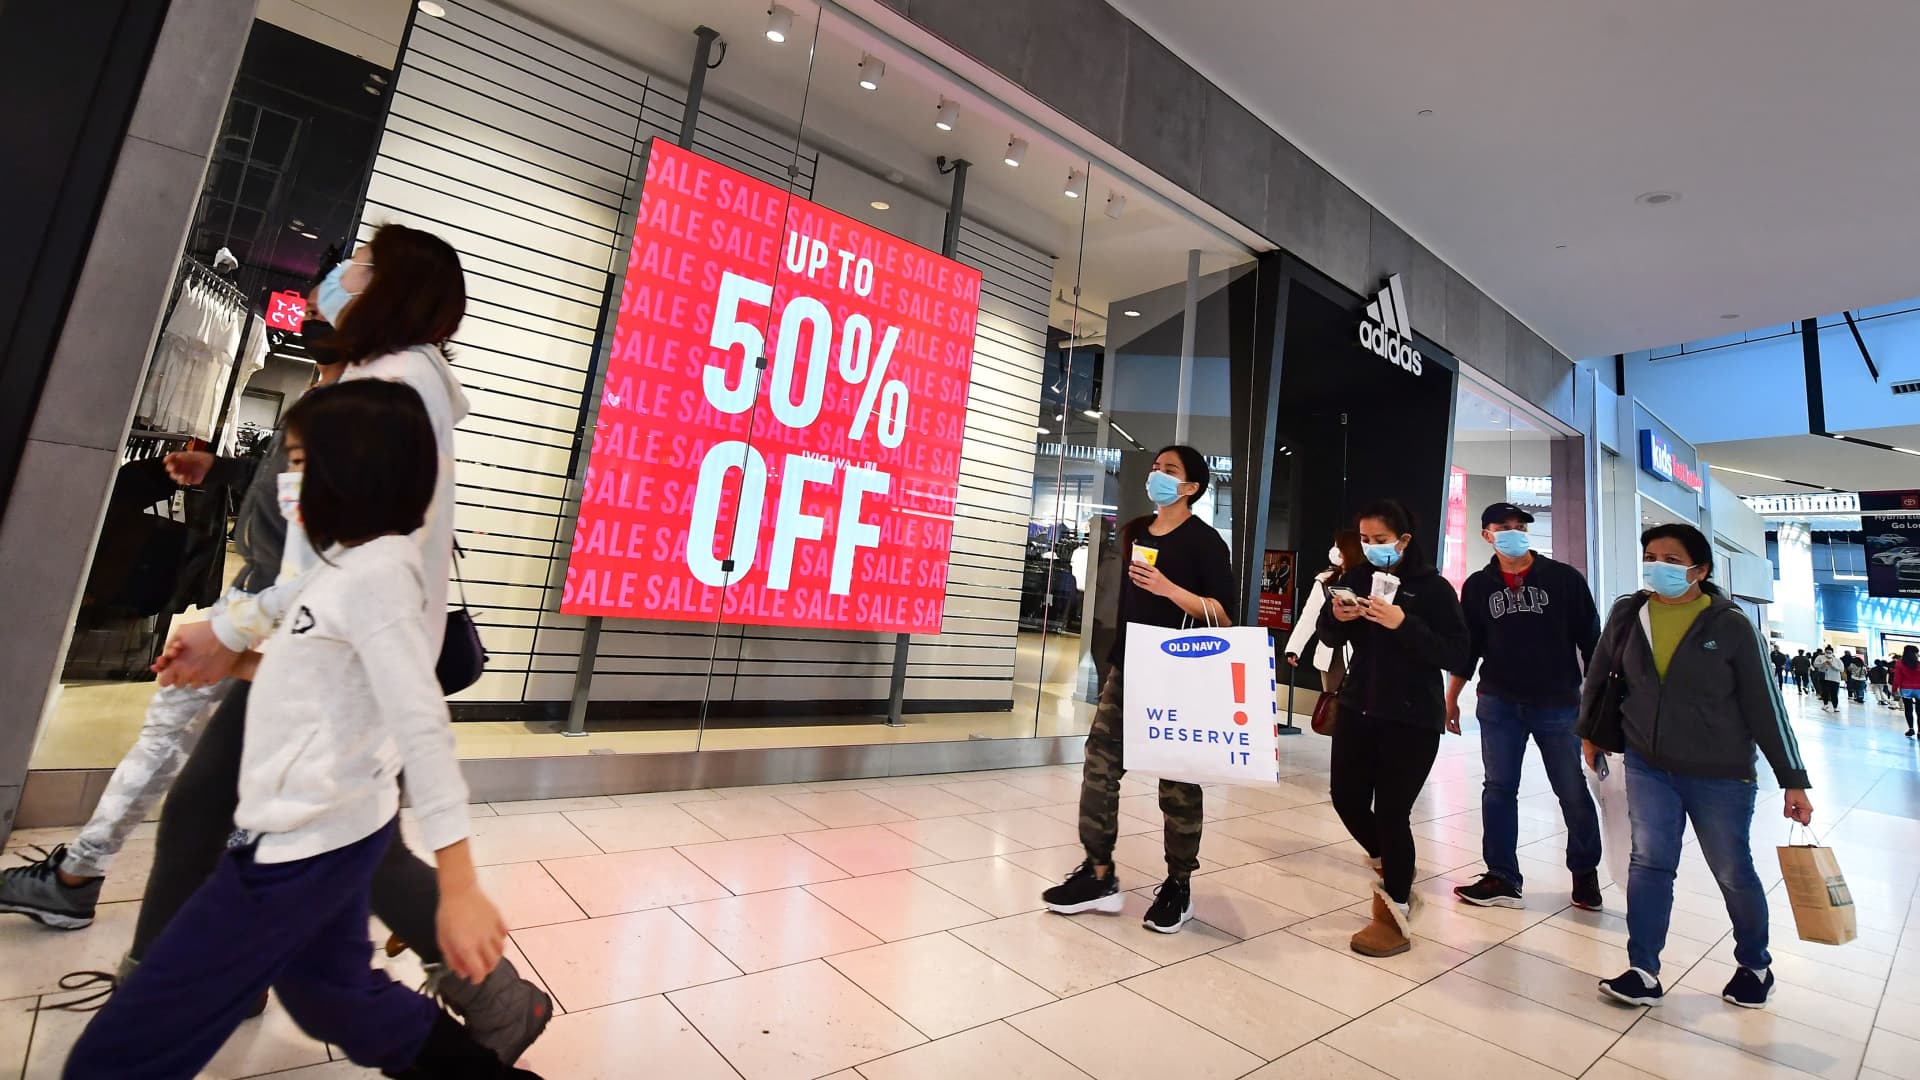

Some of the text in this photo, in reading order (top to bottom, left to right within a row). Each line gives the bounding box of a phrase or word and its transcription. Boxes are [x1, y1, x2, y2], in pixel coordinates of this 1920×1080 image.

[716, 178, 780, 228] SALE
[901, 252, 948, 291] SALE
[709, 219, 773, 267] SALE
[897, 287, 943, 326] SALE
[786, 231, 829, 279] UP
[838, 248, 874, 297] TO
[703, 271, 909, 449] 50%
[1359, 321, 1422, 376] adidas
[661, 481, 731, 520] SAE
[686, 441, 891, 595] OFF
[653, 528, 724, 566] SAE
[861, 553, 912, 585] SALE
[644, 575, 716, 612] SALE
[722, 582, 787, 617] SALE
[792, 588, 850, 621] SALE
[855, 594, 907, 625] SALE
[1489, 586, 1549, 618] GAP
[1168, 641, 1222, 652] OLD NAVY
[1146, 707, 1177, 722] WE
[1149, 726, 1250, 746] DESERVE
[1231, 752, 1250, 765] IT
